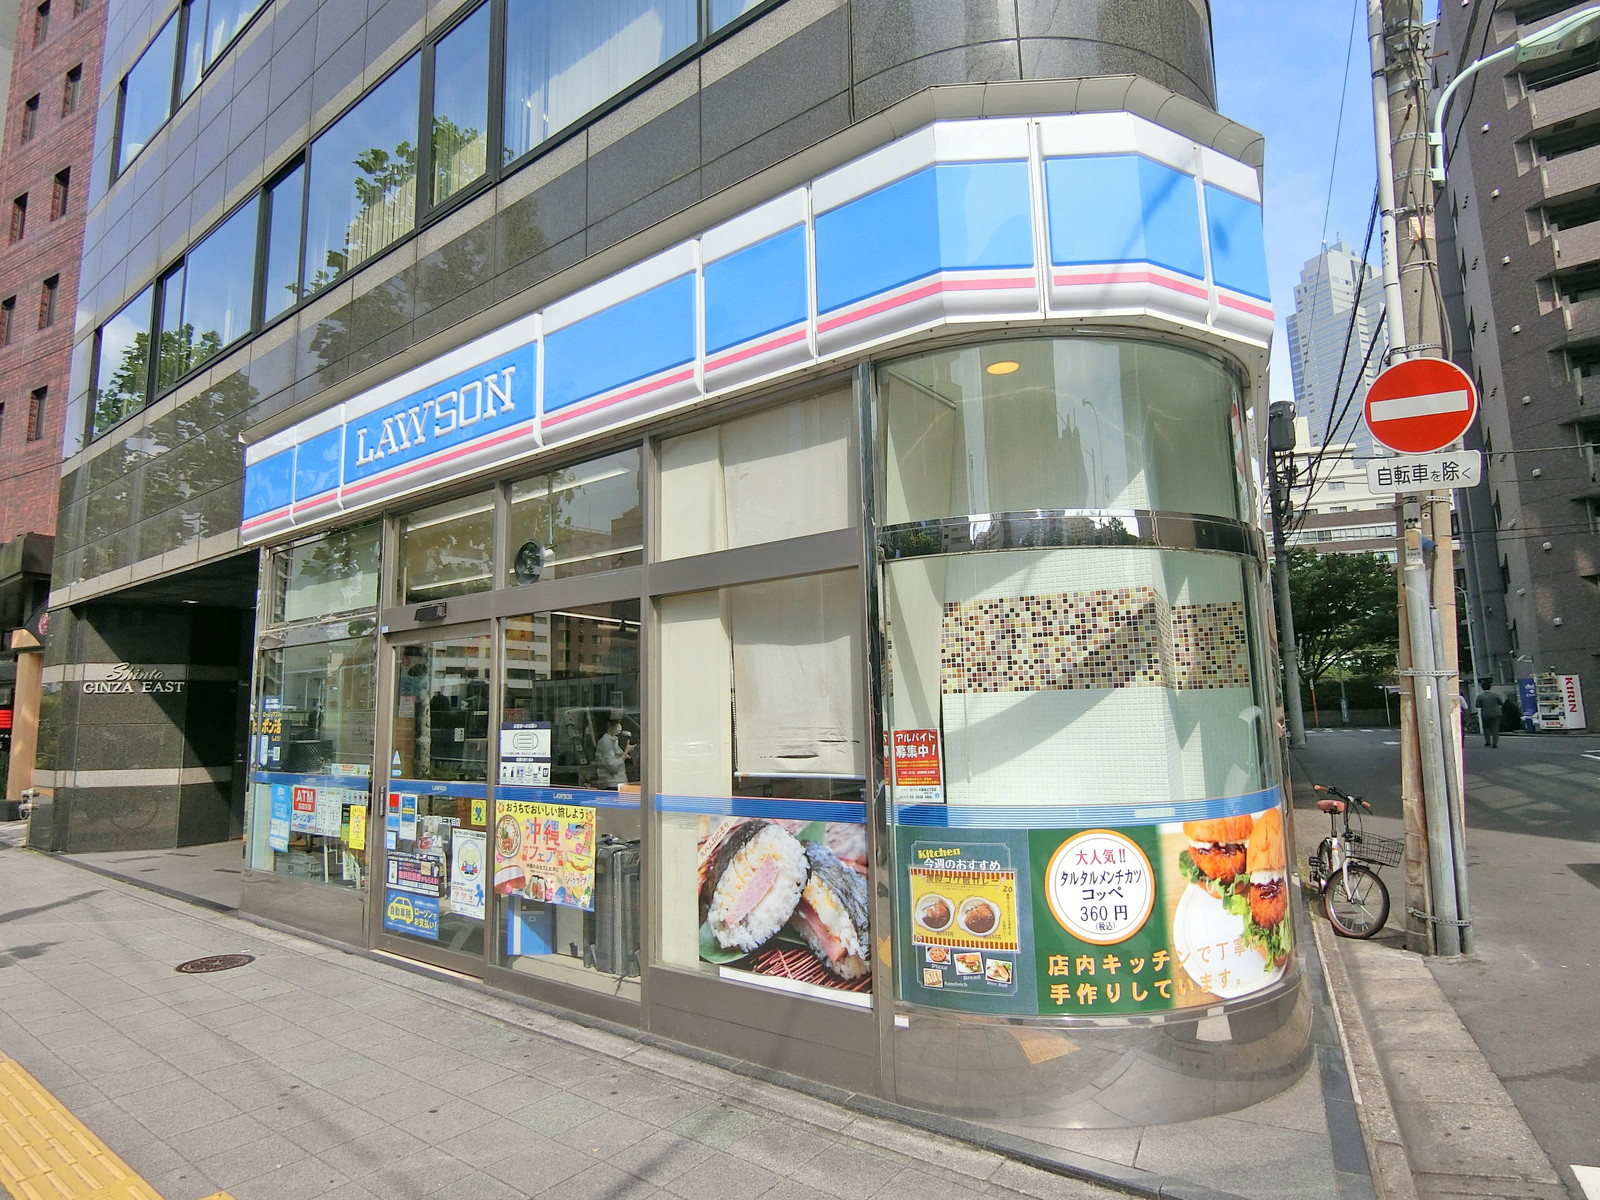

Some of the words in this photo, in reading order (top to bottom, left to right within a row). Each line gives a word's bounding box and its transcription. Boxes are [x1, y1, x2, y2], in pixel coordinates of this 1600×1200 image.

[356, 366, 516, 467] LAWSON
[1377, 461, 1472, 486] 自転車を除く
[105, 661, 163, 681] Shinto
[83, 681, 134, 693] GINZA
[141, 681, 184, 693] EAST
[1565, 677, 1577, 713] KIRIN
[896, 732, 935, 742] アルバイト
[296, 789, 314, 803] ATM
[506, 803, 585, 820] おうちでおいしい旅しよう
[525, 816, 561, 847] 沖縄
[528, 845, 558, 863] フェア
[917, 848, 961, 859] Kitchen
[923, 858, 1001, 871] 今週のおすすめ
[1060, 869, 1142, 887] タルタルメンチカツ
[1082, 886, 1124, 901] コッペ
[414, 907, 437, 920] ローソンで
[1080, 904, 1128, 921] 360円
[1095, 922, 1116, 931] (税込)
[931, 963, 948, 971] Pizza
[1050, 968, 1242, 1005] 手作りしています。
